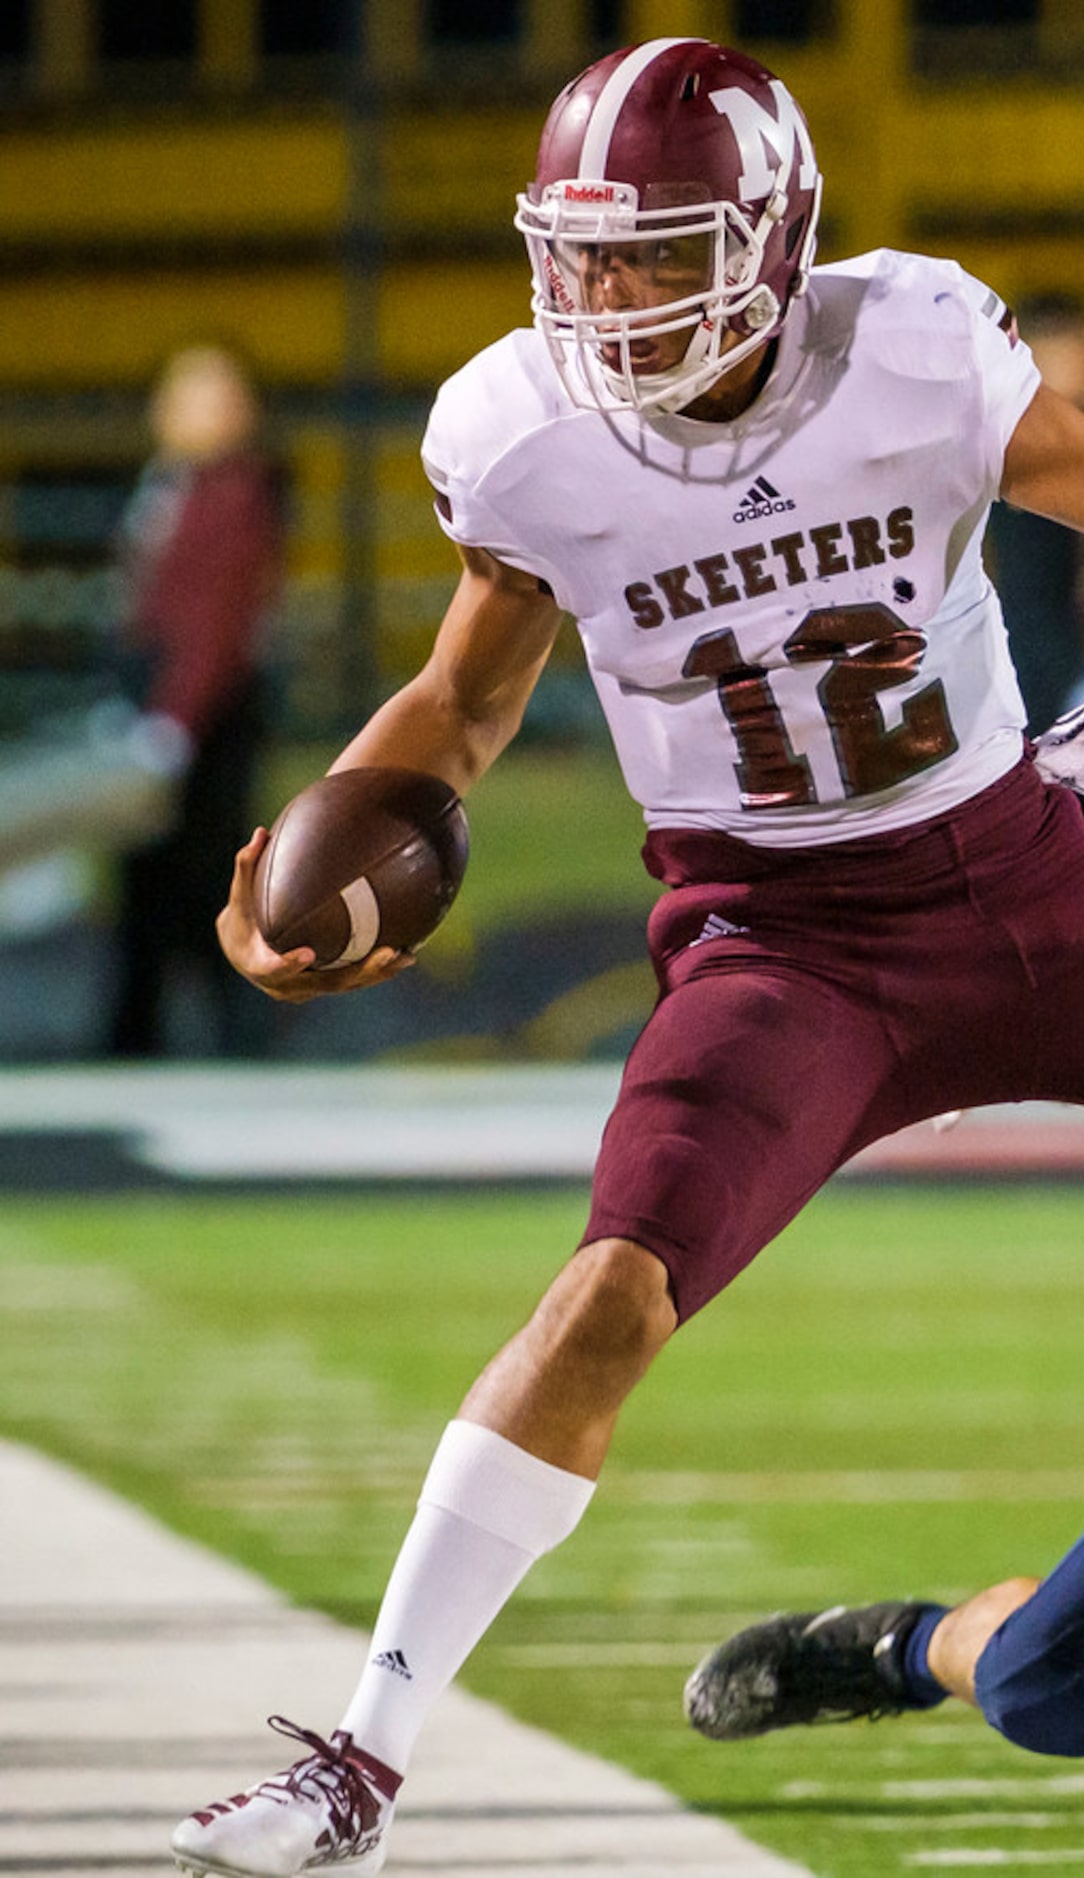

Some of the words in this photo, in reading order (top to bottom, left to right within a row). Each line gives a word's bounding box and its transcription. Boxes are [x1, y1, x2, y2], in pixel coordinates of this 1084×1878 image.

[564, 184, 614, 202] Riddell
[708, 79, 817, 201] M
[624, 506, 915, 629] SKEETERS
[733, 497, 796, 523] adidas
[682, 602, 960, 811] 12
